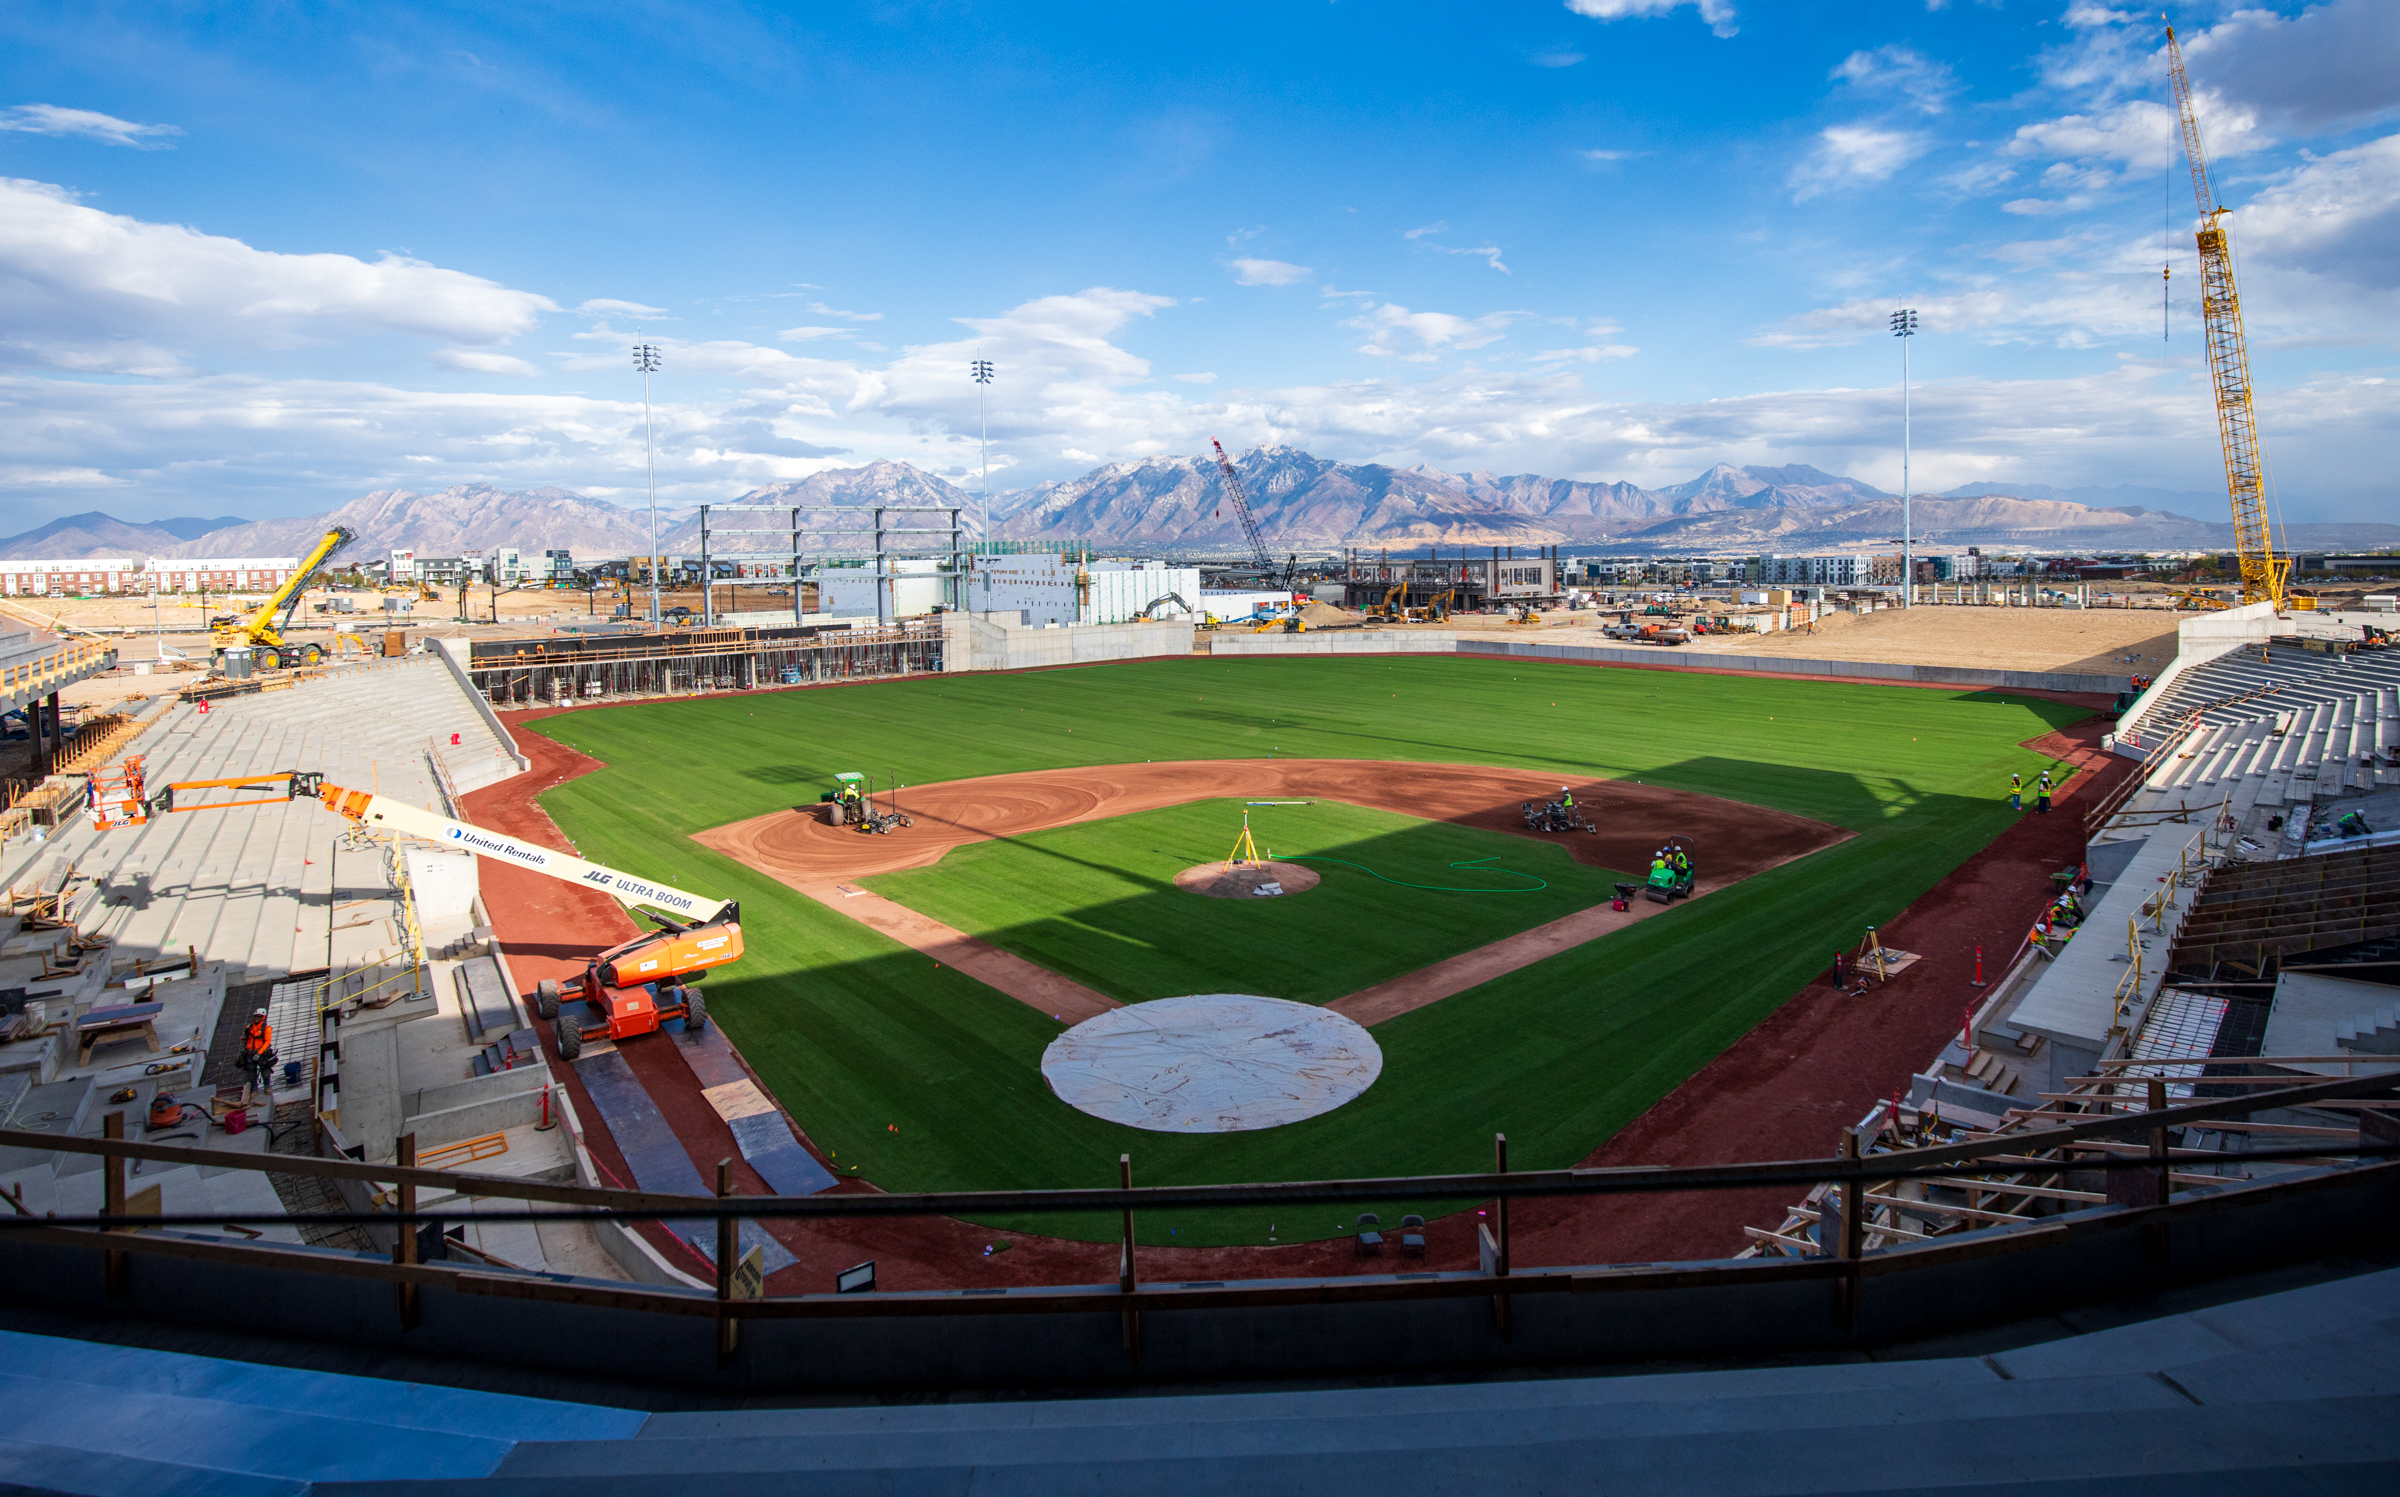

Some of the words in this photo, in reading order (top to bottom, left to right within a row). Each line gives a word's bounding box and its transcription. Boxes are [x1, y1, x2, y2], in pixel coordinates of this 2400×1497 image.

[463, 832, 504, 852] United
[503, 845, 546, 865] Rentals
[582, 870, 613, 885] JLG
[616, 879, 654, 898] ULTRA
[655, 891, 693, 910] BOOM
